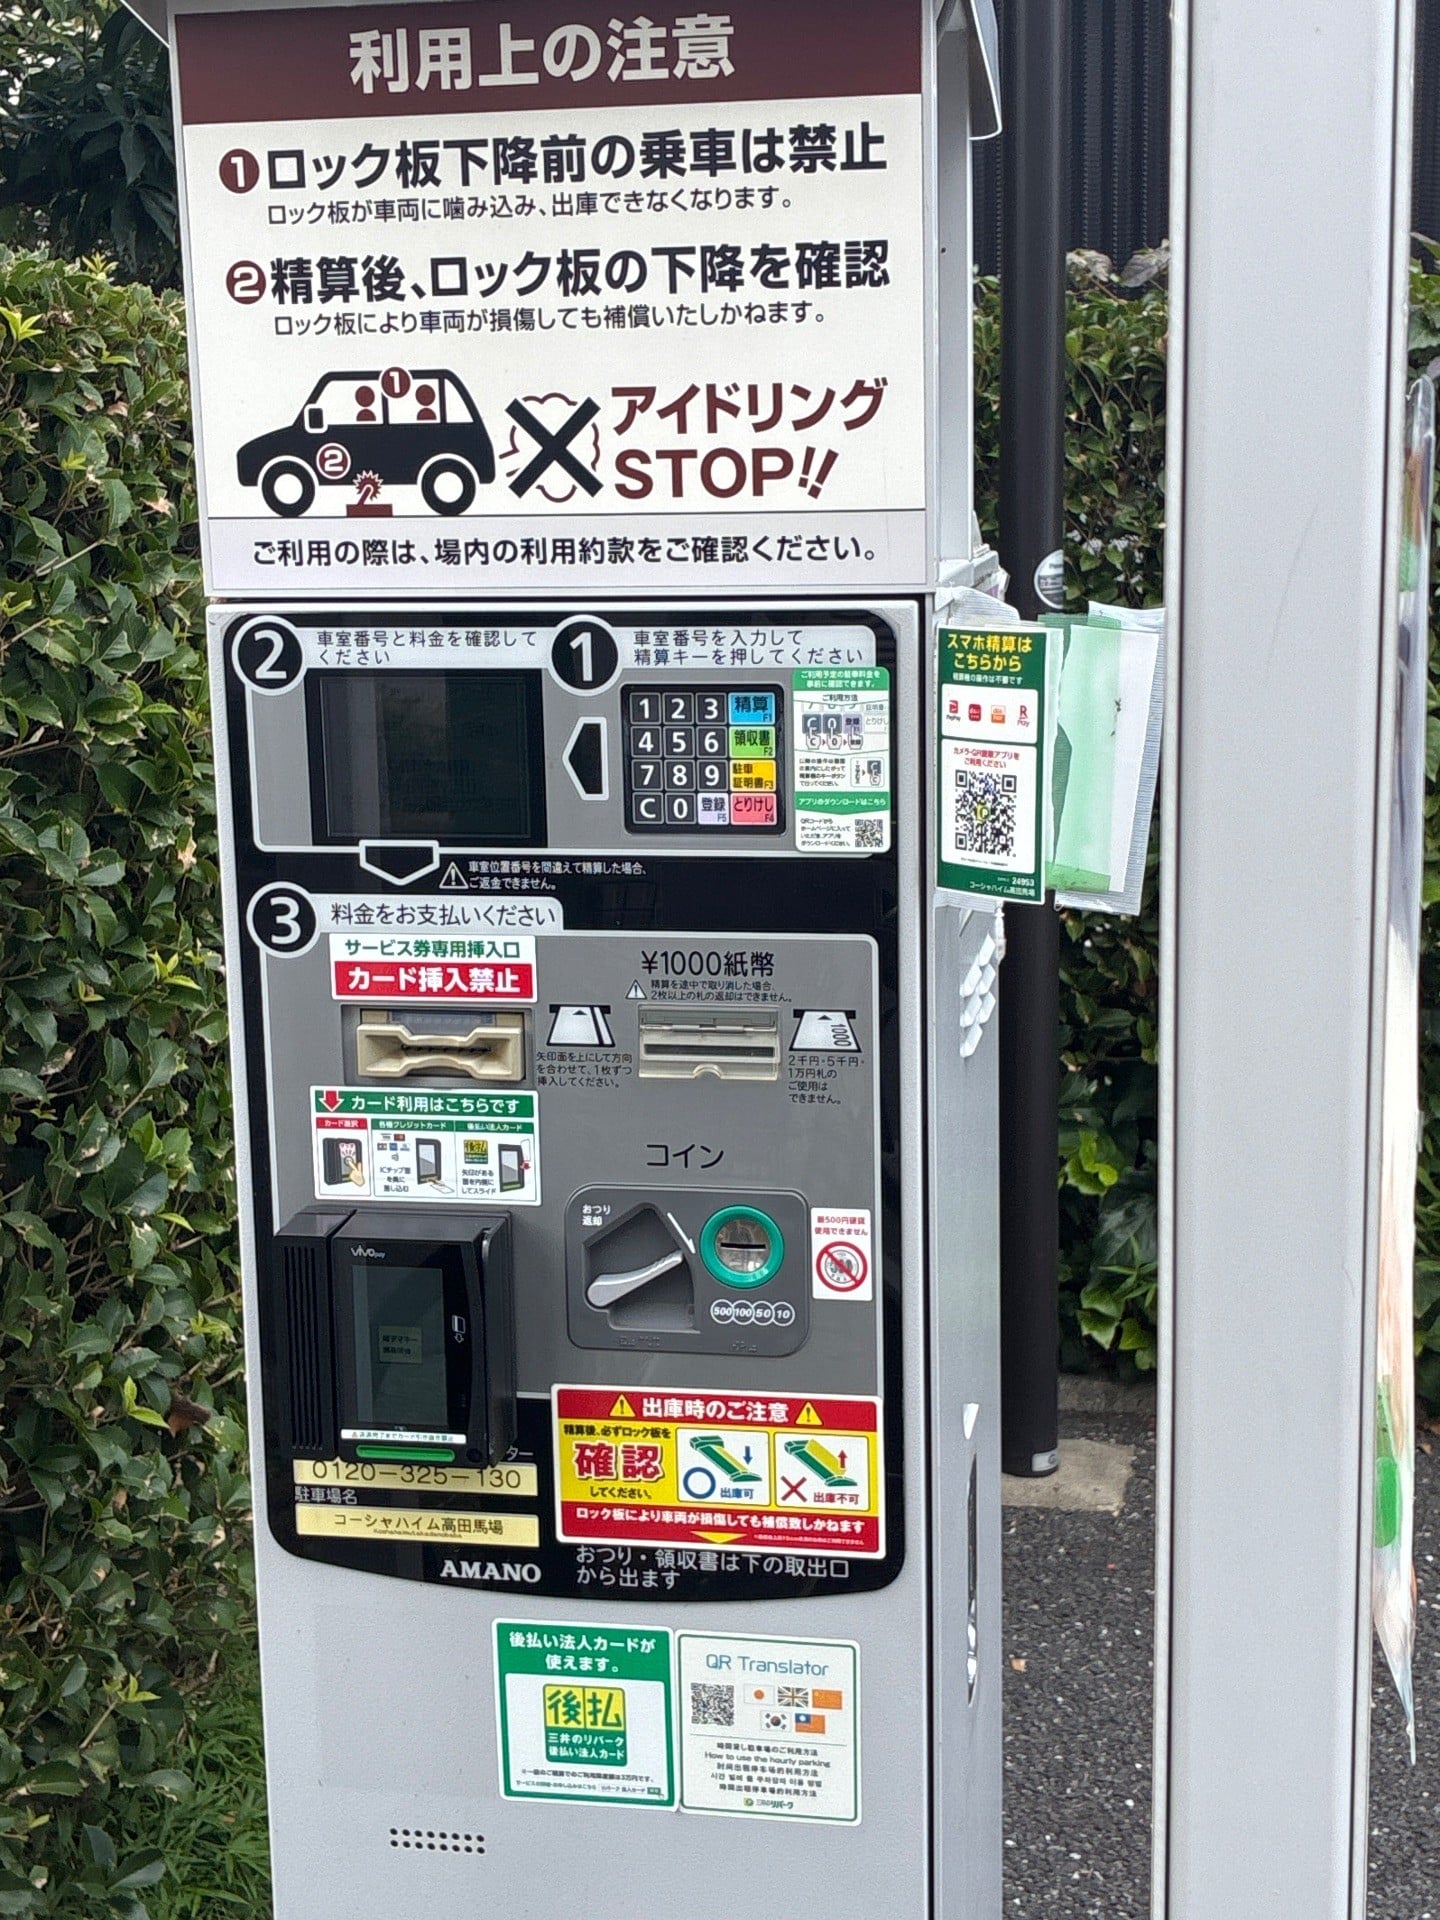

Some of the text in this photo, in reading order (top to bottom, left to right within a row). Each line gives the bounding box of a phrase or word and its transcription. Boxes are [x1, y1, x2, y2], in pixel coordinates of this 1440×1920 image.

[349, 13, 735, 94] 利用上の注意
[268, 122, 887, 191] ロック板下降前の乗車は禁止
[268, 187, 793, 226] ロック板が車両に噛み込み、出庫できなくなります。
[272, 240, 890, 305] 精算後、ロック板の下降を確認
[274, 303, 826, 338] ロック板により車両が損傷しても補償いたしかねます。
[611, 377, 889, 435] アイドリング
[613, 446, 839, 500] STOP!!
[253, 535, 877, 568] ご利用の際は、場内の利用約款をご確認ください。
[317, 630, 538, 648] 車室番号と料金を確認して
[633, 629, 803, 648] 車室番号を入力して
[946, 633, 1033, 653] スマホ精算は
[253, 629, 288, 680] 2
[318, 649, 391, 666] ください
[569, 632, 595, 682] 1
[633, 648, 864, 667] 精算キーを押してください
[953, 652, 1023, 672] こちらから
[638, 698, 652, 719] 1
[671, 698, 686, 719] 2
[704, 698, 719, 719] 3
[733, 695, 769, 713] 精算
[637, 731, 655, 752] 4
[671, 731, 687, 752] 5
[704, 731, 720, 752] 6
[733, 730, 771, 747] 領収書
[640, 764, 655, 786] 7
[672, 764, 688, 786] 8
[704, 764, 720, 786] 9
[732, 762, 754, 775] 駐車
[732, 776, 763, 790] 証明書
[639, 798, 656, 819] C
[701, 797, 728, 813] 登録
[732, 797, 774, 813] とりけし
[469, 876, 557, 890] ご返金できません。
[269, 896, 302, 945] 3
[331, 902, 556, 926] 料金をお支払いください
[345, 939, 520, 960] サービス券専用挿入口
[348, 967, 520, 992] カード挿入禁止
[536, 1052, 633, 1065] 矢印面を上にして方向
[537, 1076, 621, 1089] 挿入してください。
[788, 1081, 828, 1093] ご使用は
[351, 1095, 520, 1113] カード利用はこちらです
[788, 1093, 842, 1106] できません。
[647, 1143, 725, 1170] コイン
[582, 1204, 612, 1216] おつり
[582, 1215, 604, 1227] 返却
[642, 1397, 790, 1423] 出庫時のご注意
[573, 1442, 665, 1481] 確認
[295, 1485, 358, 1505] 駐車場名
[590, 1486, 653, 1500] してください。
[720, 1486, 754, 1500] 出庫可
[813, 1491, 860, 1505] 出庫不可
[334, 1513, 504, 1535] コーシャハイム高田馬場
[440, 1558, 541, 1583] AMANO
[576, 1544, 849, 1579] おつり・領収書は下の取出口
[576, 1566, 681, 1590] から出ます
[509, 1631, 656, 1654] 後払い法人カードが
[545, 1653, 620, 1674] 使えます。
[705, 1653, 829, 1677] QR Translator
[547, 1689, 623, 1728] 後払
